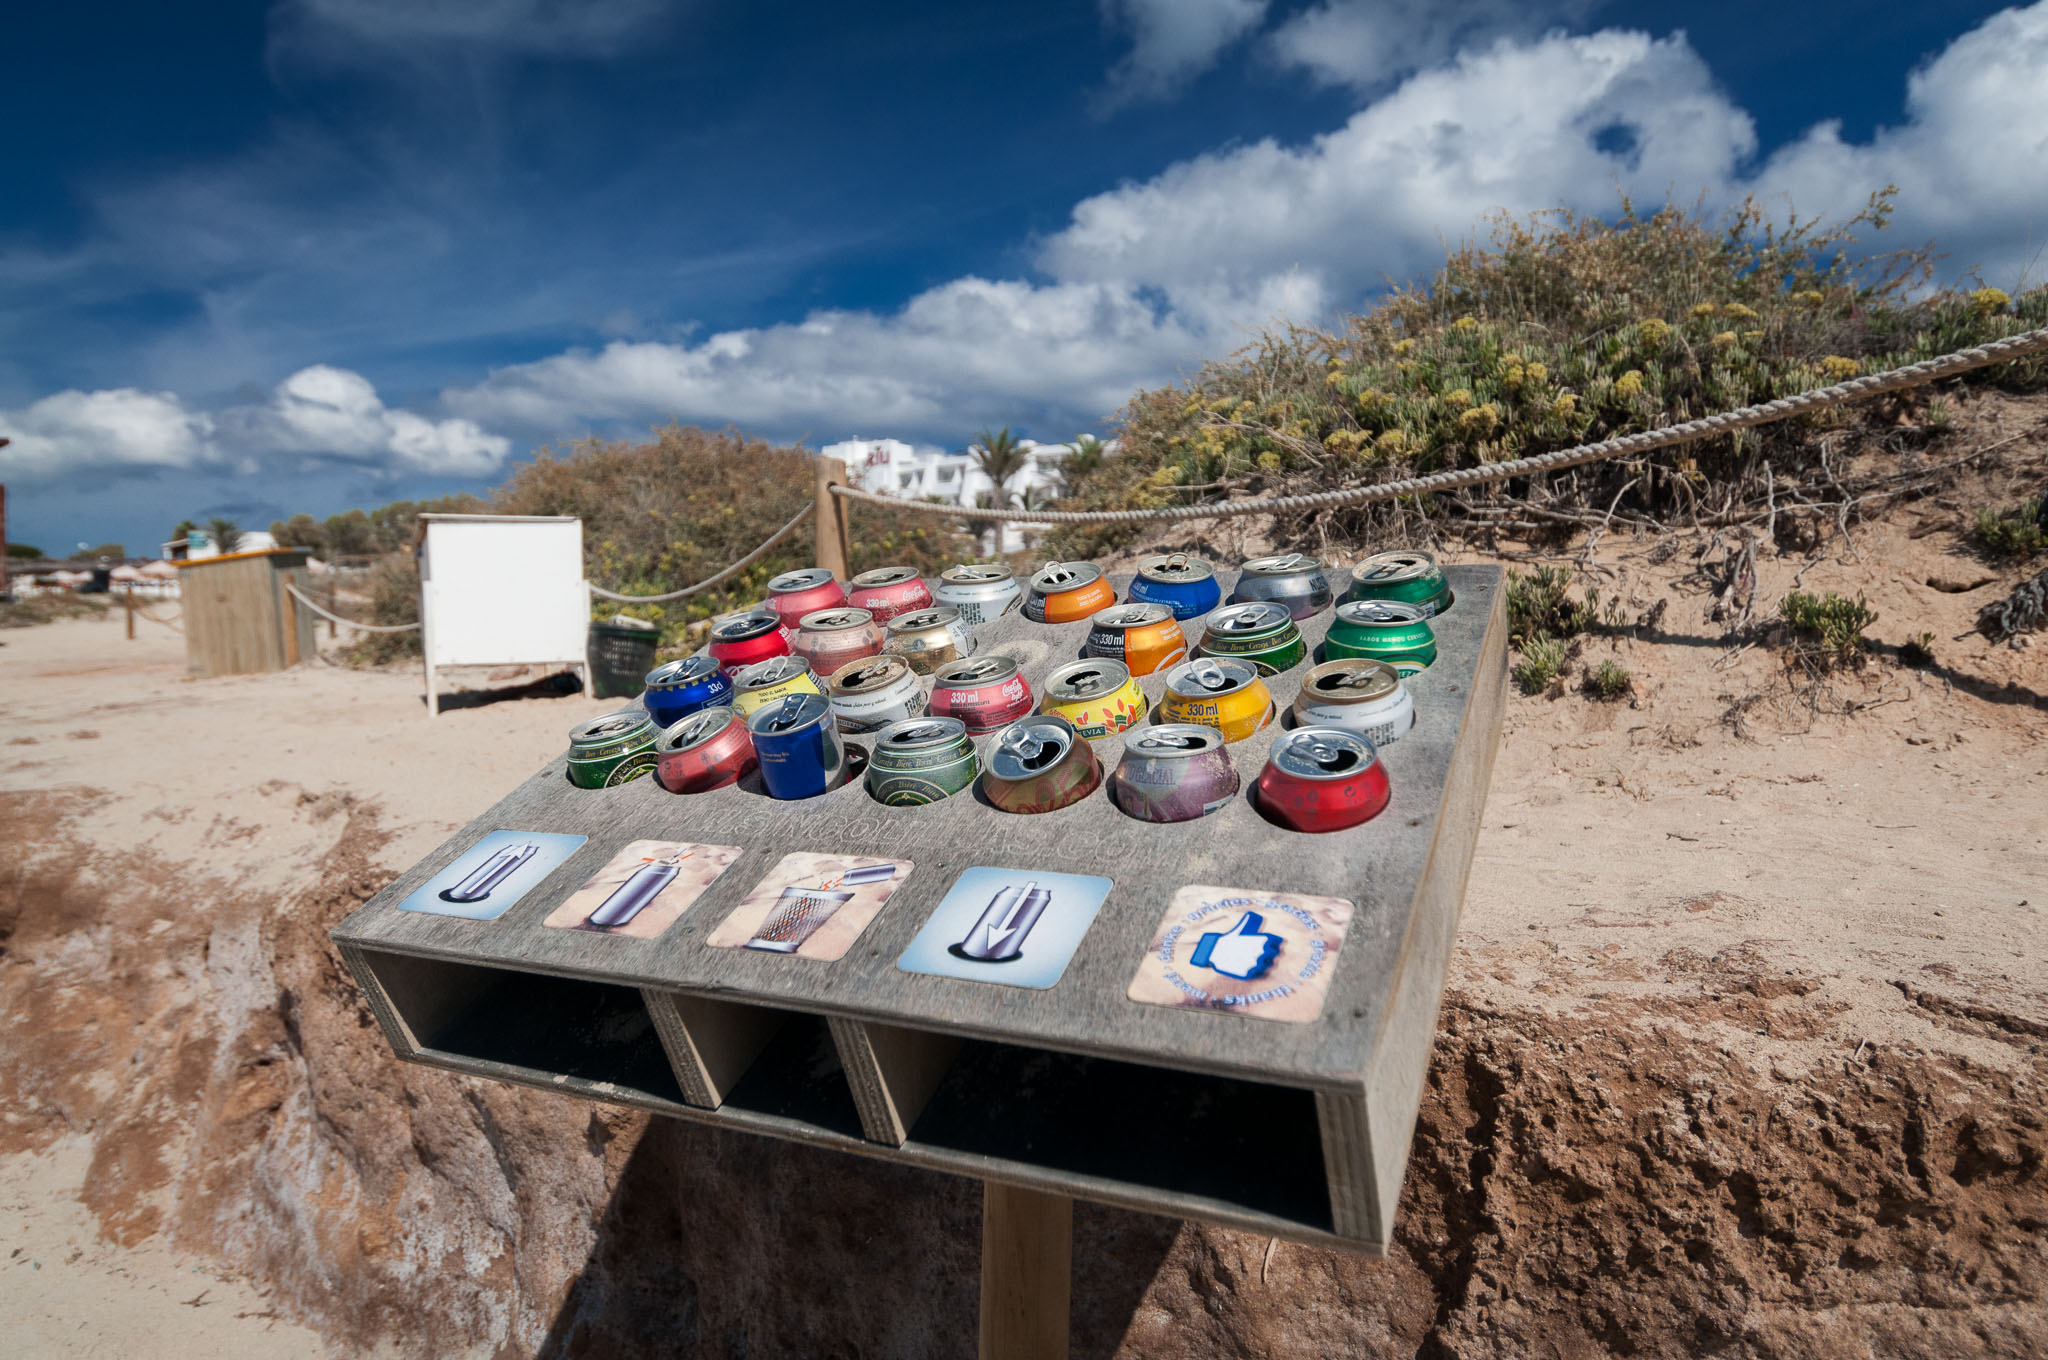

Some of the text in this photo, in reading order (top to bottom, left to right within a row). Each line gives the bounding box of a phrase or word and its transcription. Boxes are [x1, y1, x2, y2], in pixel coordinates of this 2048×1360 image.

[866, 448, 891, 467] RIU
[1100, 633, 1125, 646] 330 ml
[707, 681, 724, 694] 33cl
[950, 690, 979, 703] 330 ml
[1187, 702, 1218, 716] 330 ml
[1222, 983, 1293, 1007] thanks
